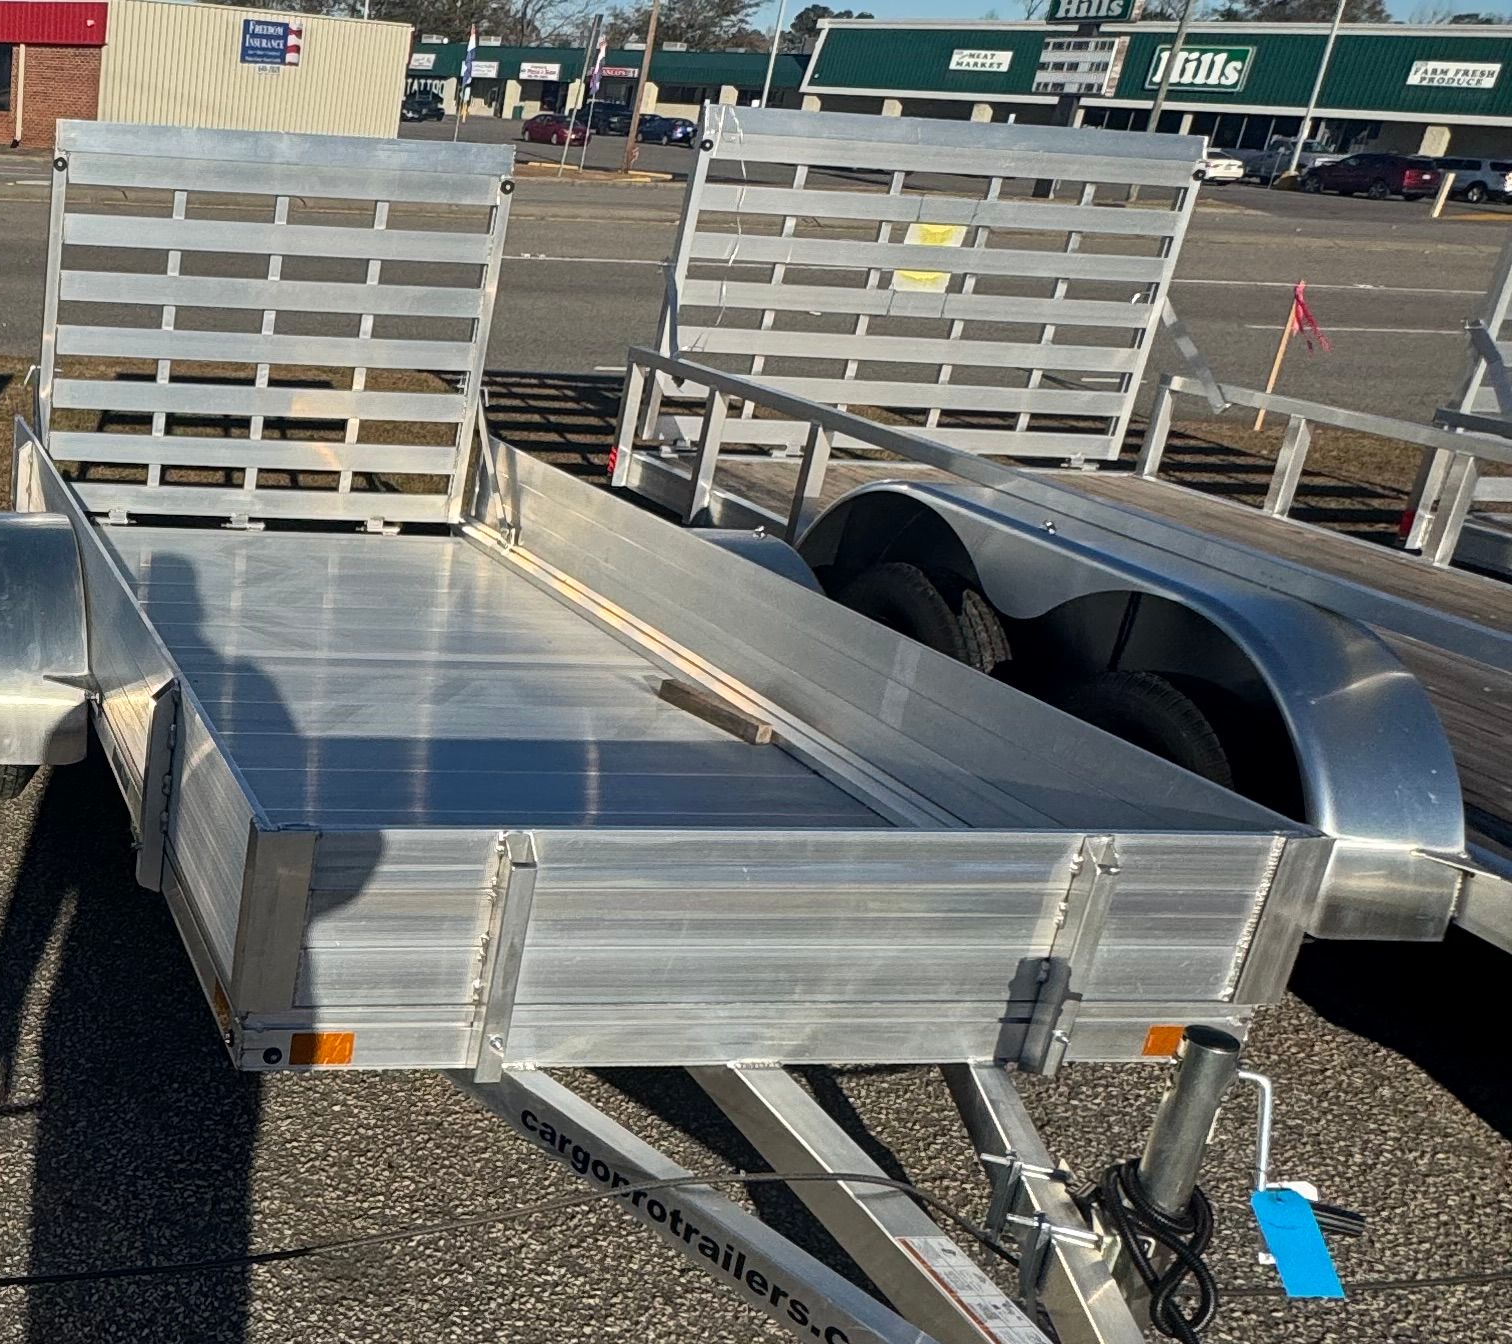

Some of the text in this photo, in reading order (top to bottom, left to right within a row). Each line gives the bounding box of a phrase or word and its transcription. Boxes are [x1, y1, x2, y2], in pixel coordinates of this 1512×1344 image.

[249, 21, 284, 36] FREEDOM
[245, 34, 285, 49] INSURANCE
[968, 52, 996, 60] MEAT
[955, 60, 1003, 69] MARKET
[1151, 51, 1243, 86] Hills
[1414, 66, 1496, 79] FARM FRESH
[406, 78, 447, 98] TATTOO
[1418, 77, 1485, 87] PRODUCE
